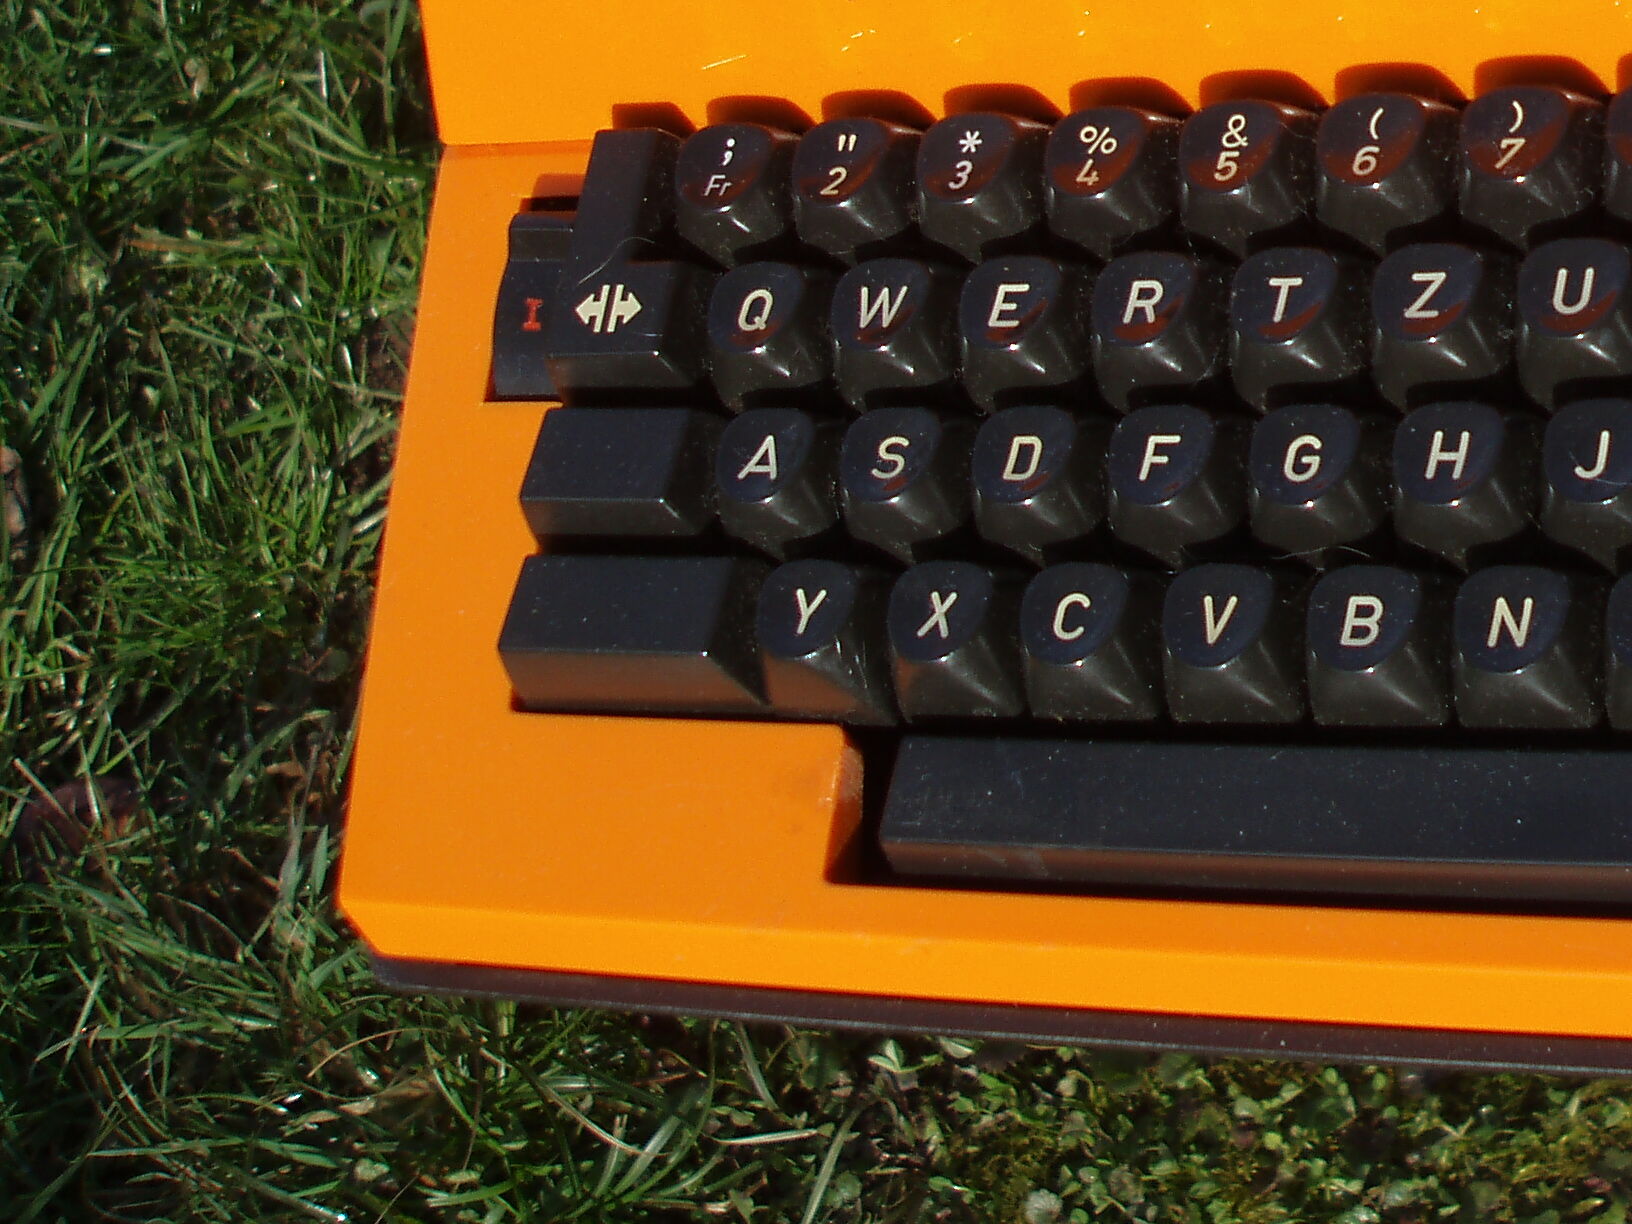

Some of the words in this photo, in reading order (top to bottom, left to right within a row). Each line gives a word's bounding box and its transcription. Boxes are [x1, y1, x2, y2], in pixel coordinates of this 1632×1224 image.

[1079, 125, 1117, 155] %
[1221, 114, 1249, 148] &
[1495, 137, 1526, 169] 7
[820, 166, 847, 195] 2
[948, 160, 973, 189] 3
[1075, 158, 1099, 186] 4
[1214, 150, 1240, 181] 5
[1352, 145, 1380, 175] 6
[738, 289, 773, 331] Q
[859, 285, 908, 328] W
[988, 283, 1030, 327] E
[1123, 279, 1164, 324] R
[1268, 277, 1303, 323] T
[1404, 271, 1447, 318] Z
[1552, 267, 1595, 314] U
[737, 434, 777, 480] A
[871, 436, 910, 479] S
[1002, 435, 1043, 481] D
[1139, 435, 1181, 481] F
[1284, 435, 1322, 482] G
[1425, 430, 1470, 480] H
[1574, 430, 1610, 479] J
[796, 588, 827, 634] Y
[917, 591, 958, 638] X
[1053, 593, 1091, 640] C
[1203, 595, 1238, 644] V
[1340, 595, 1384, 646] B
[1487, 596, 1533, 647] N
